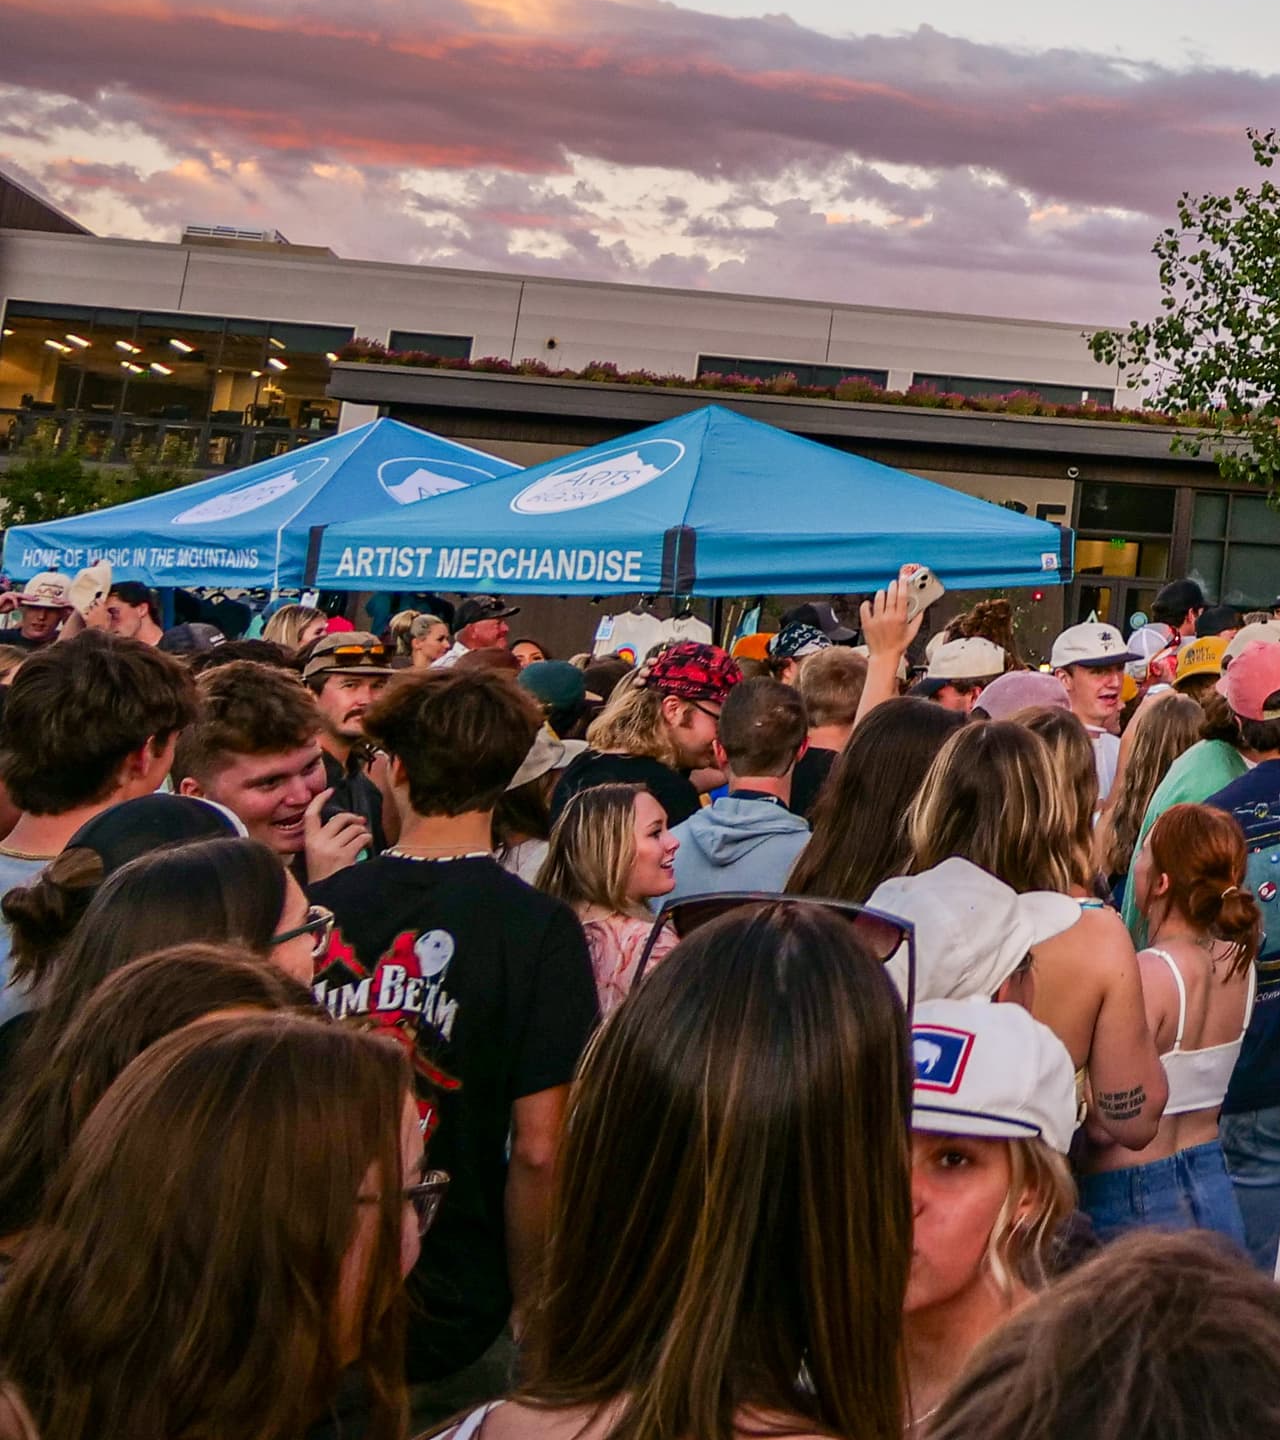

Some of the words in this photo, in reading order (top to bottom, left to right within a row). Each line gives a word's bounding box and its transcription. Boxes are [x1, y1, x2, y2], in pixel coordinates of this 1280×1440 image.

[22, 548, 61, 568] HOME
[64, 548, 83, 567] OF
[133, 548, 147, 568] IN
[149, 548, 175, 568] THE
[176, 548, 259, 569] MOUNTAINS
[336, 546, 431, 578] ARTIST
[436, 546, 643, 582] MERCHANDISE
[376, 964, 459, 1042] BEAM
